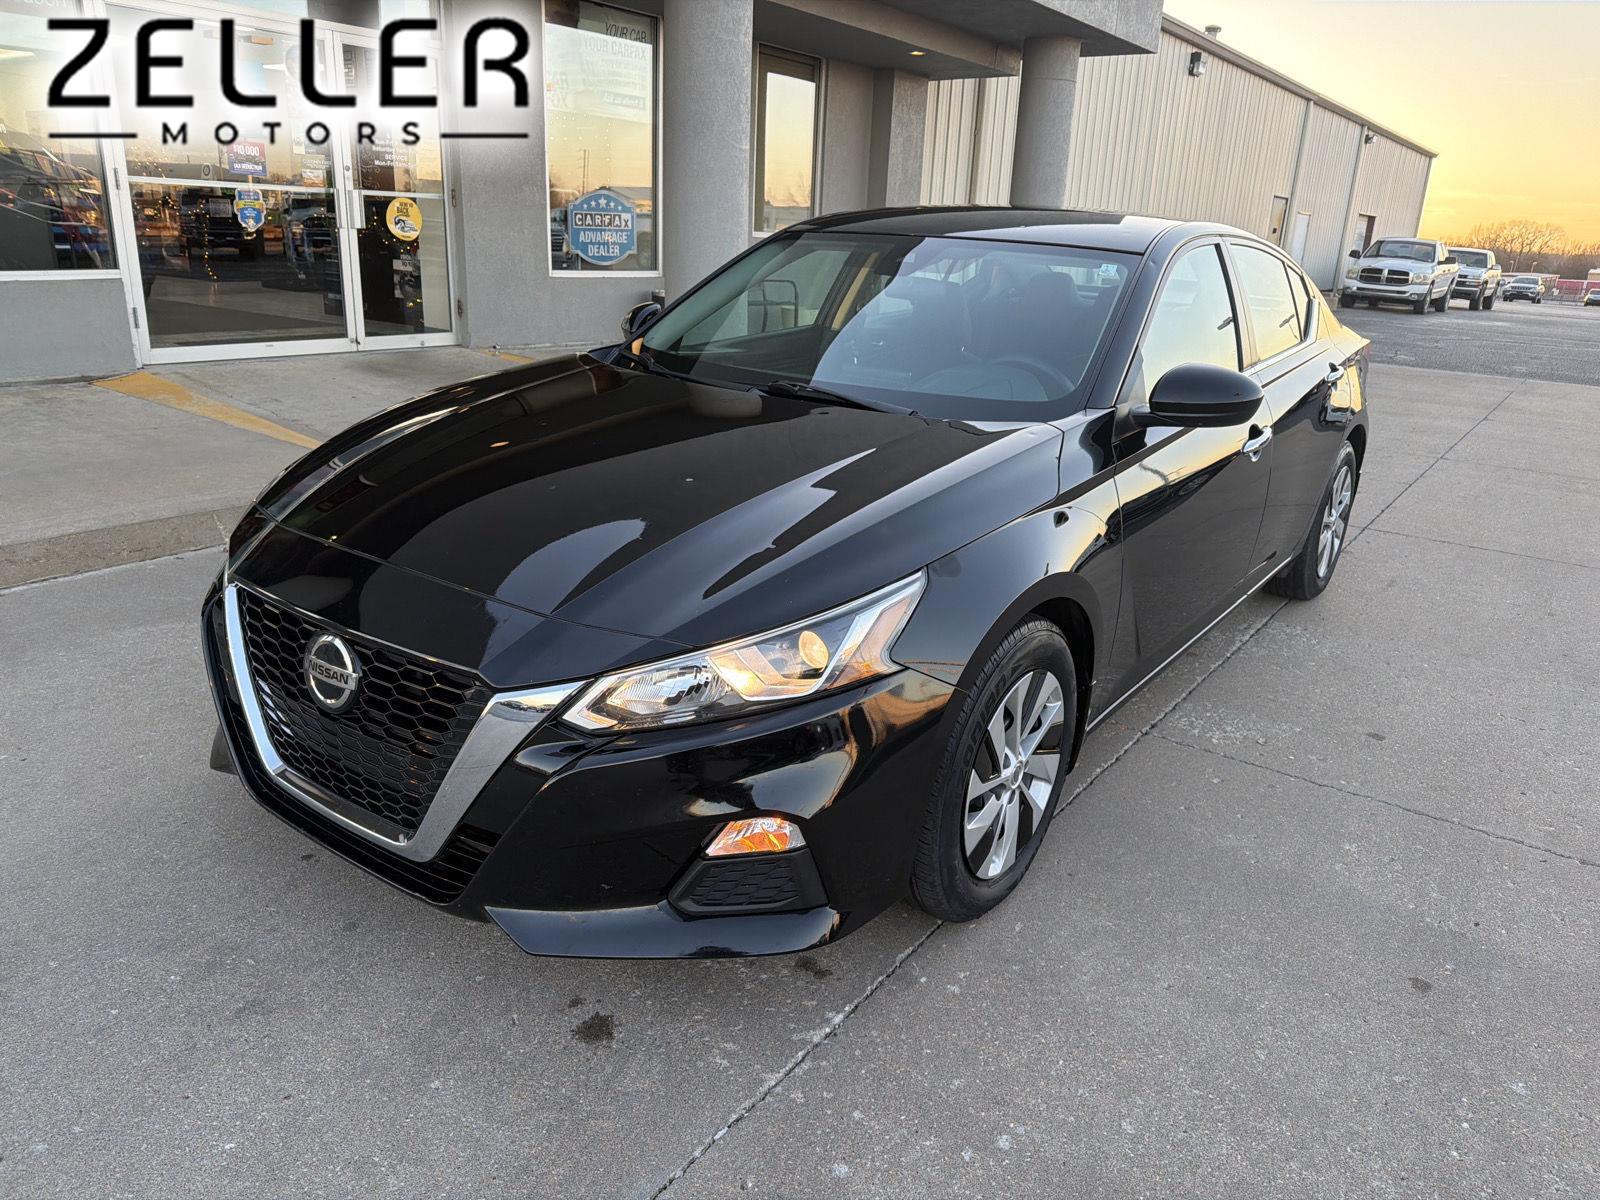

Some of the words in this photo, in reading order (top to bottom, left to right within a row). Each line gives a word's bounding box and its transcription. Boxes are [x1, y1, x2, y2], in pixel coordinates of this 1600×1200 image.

[605, 22, 628, 39] YOUR
[575, 214, 630, 228] CARFAX
[580, 231, 628, 243] ADVANTAGE
[588, 244, 620, 256] DEALER
[308, 660, 349, 685] NISSAN
